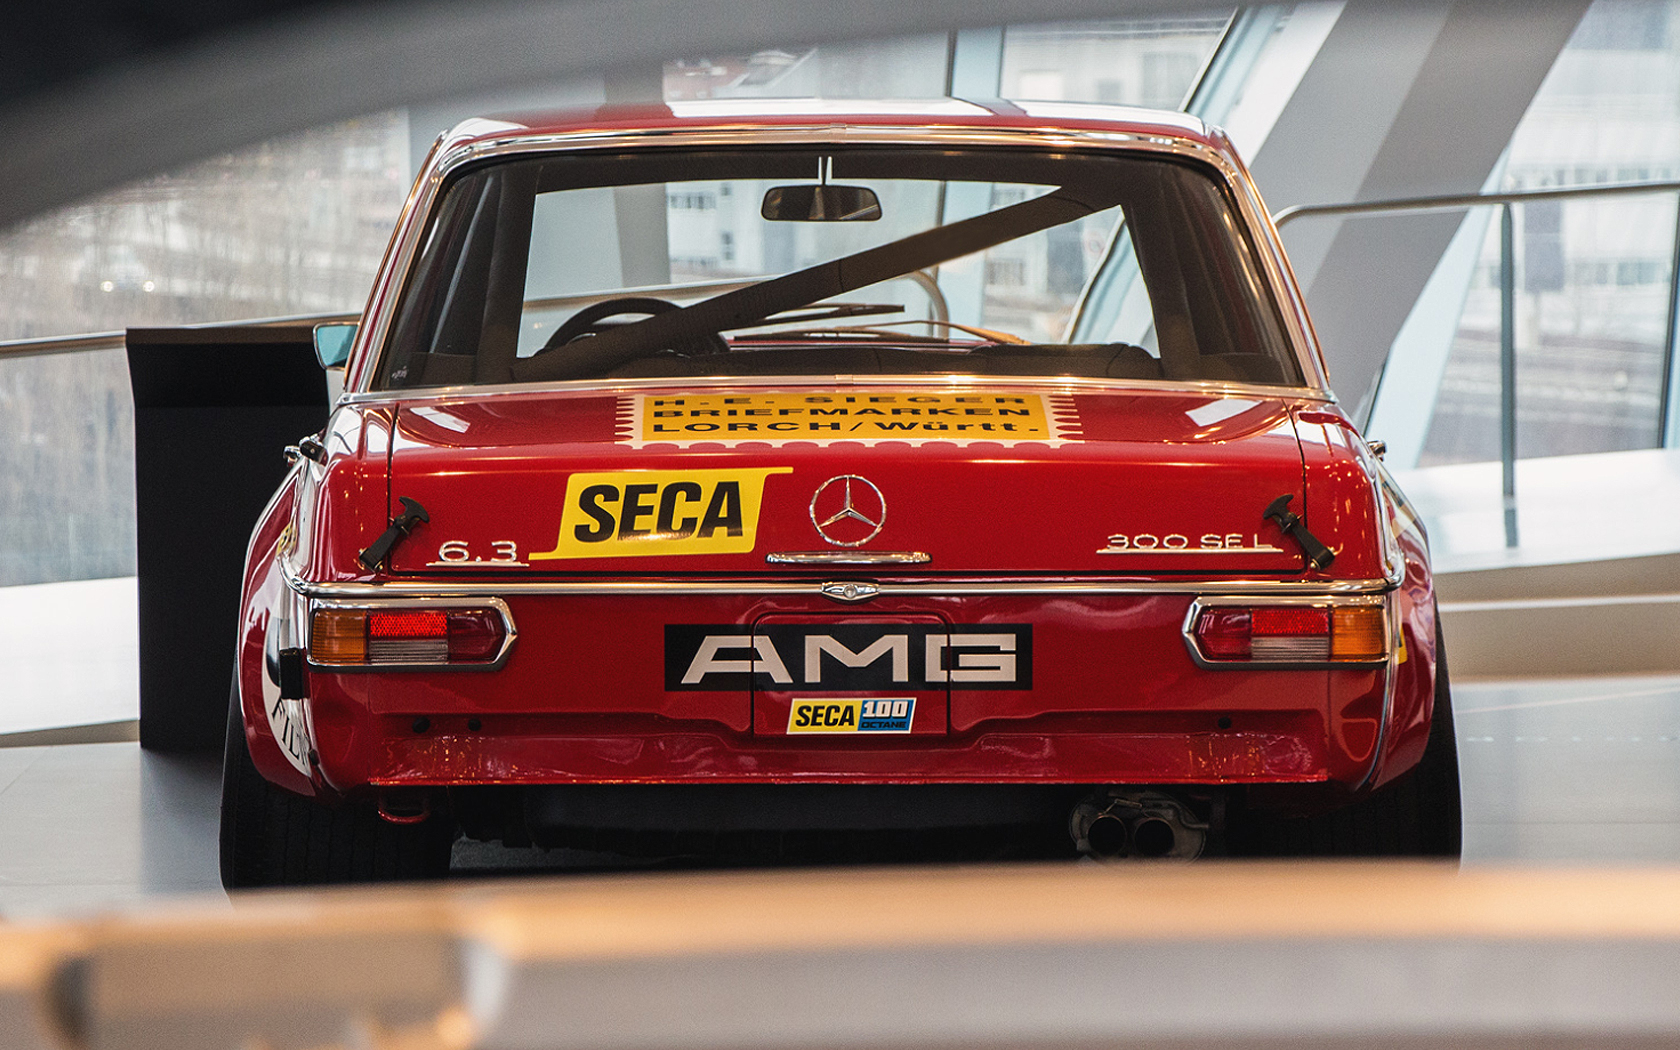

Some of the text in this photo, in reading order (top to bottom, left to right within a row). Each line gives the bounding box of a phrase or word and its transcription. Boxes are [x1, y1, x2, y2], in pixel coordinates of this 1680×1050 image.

[804, 396, 1025, 404] SIEGER
[653, 408, 1030, 418] BRIEFMARKEN
[653, 421, 1039, 432] LORCH/Württ.
[574, 481, 744, 543] SECA
[1107, 533, 1189, 550] 300
[438, 541, 518, 562] 6.3
[680, 633, 1016, 684] AMG
[795, 701, 909, 728] SECA 100
[861, 721, 907, 729] OCTANE
